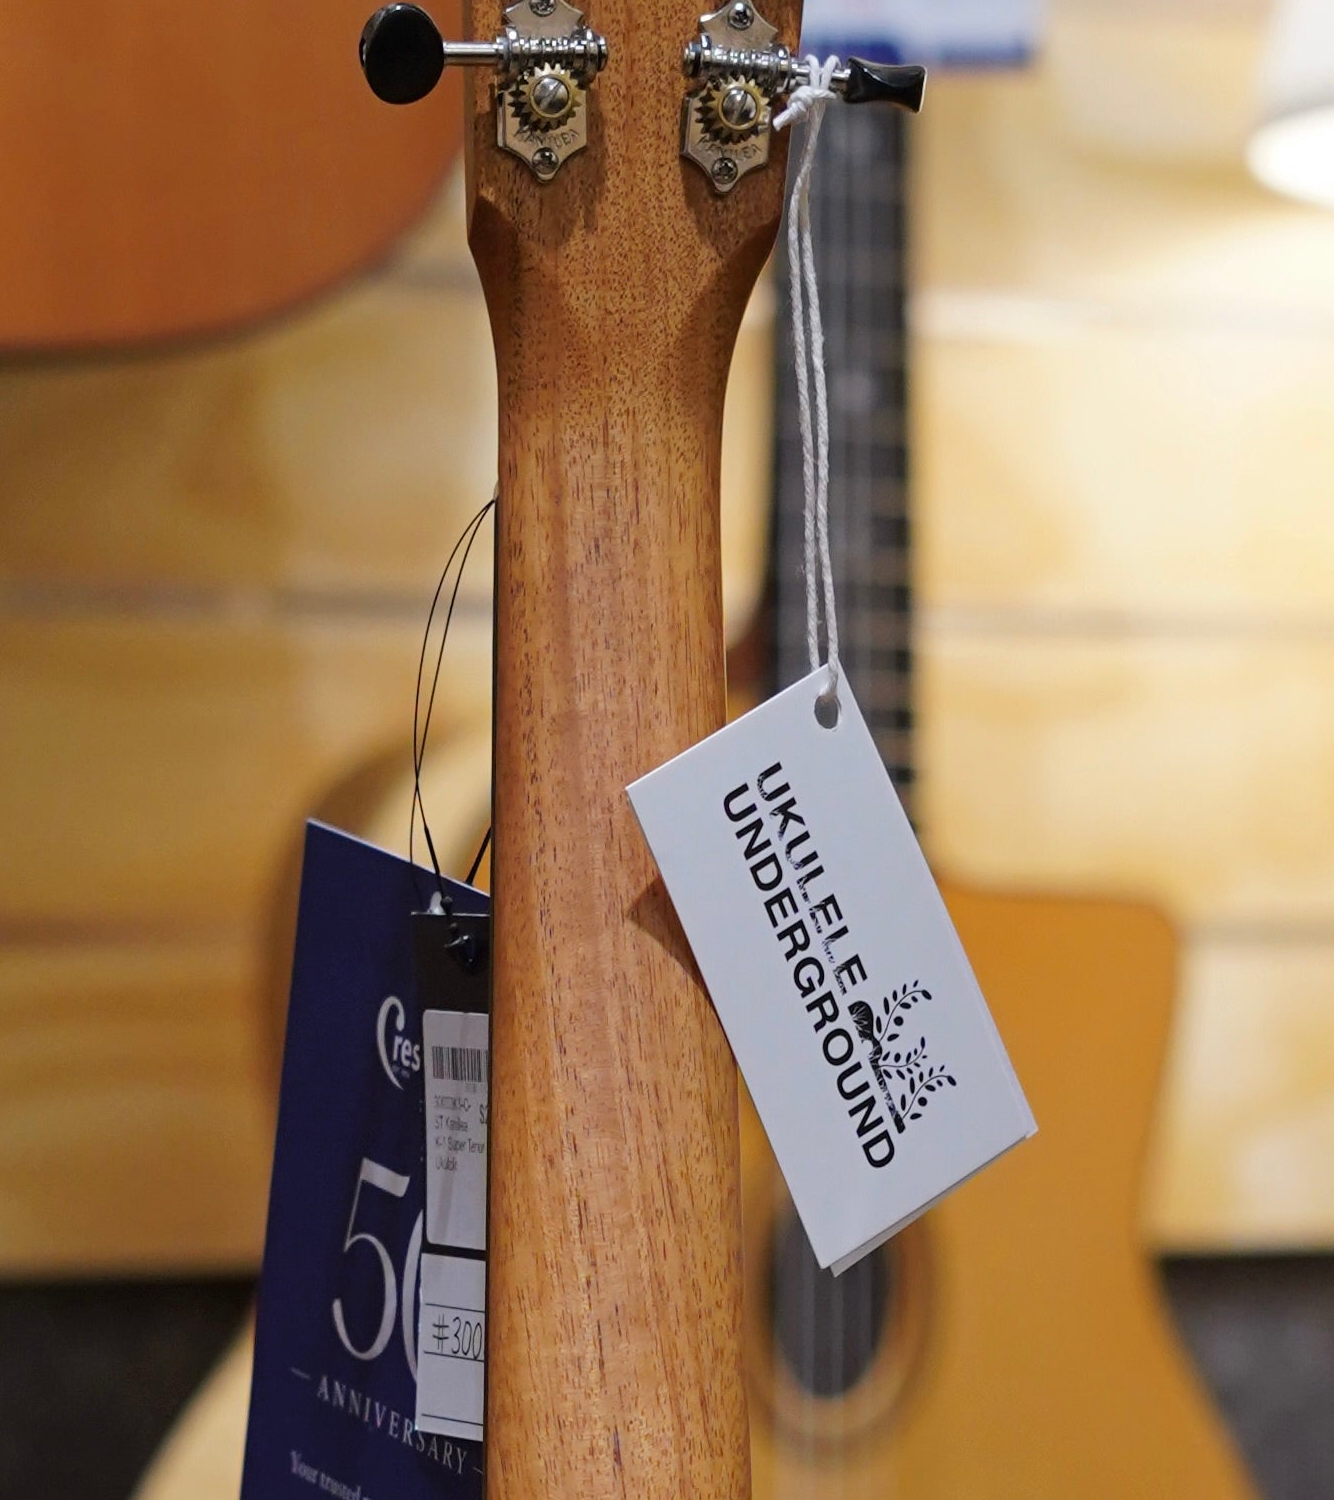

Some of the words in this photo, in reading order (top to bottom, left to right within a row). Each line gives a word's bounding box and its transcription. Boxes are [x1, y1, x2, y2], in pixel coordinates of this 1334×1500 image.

[757, 761, 869, 996] UKULELE
[723, 782, 896, 1169] UNDERGROUND
[432, 1313, 483, 1360] #300
[290, 1449, 318, 1484] Your
[317, 1374, 468, 1475] ANNIVERSARY
